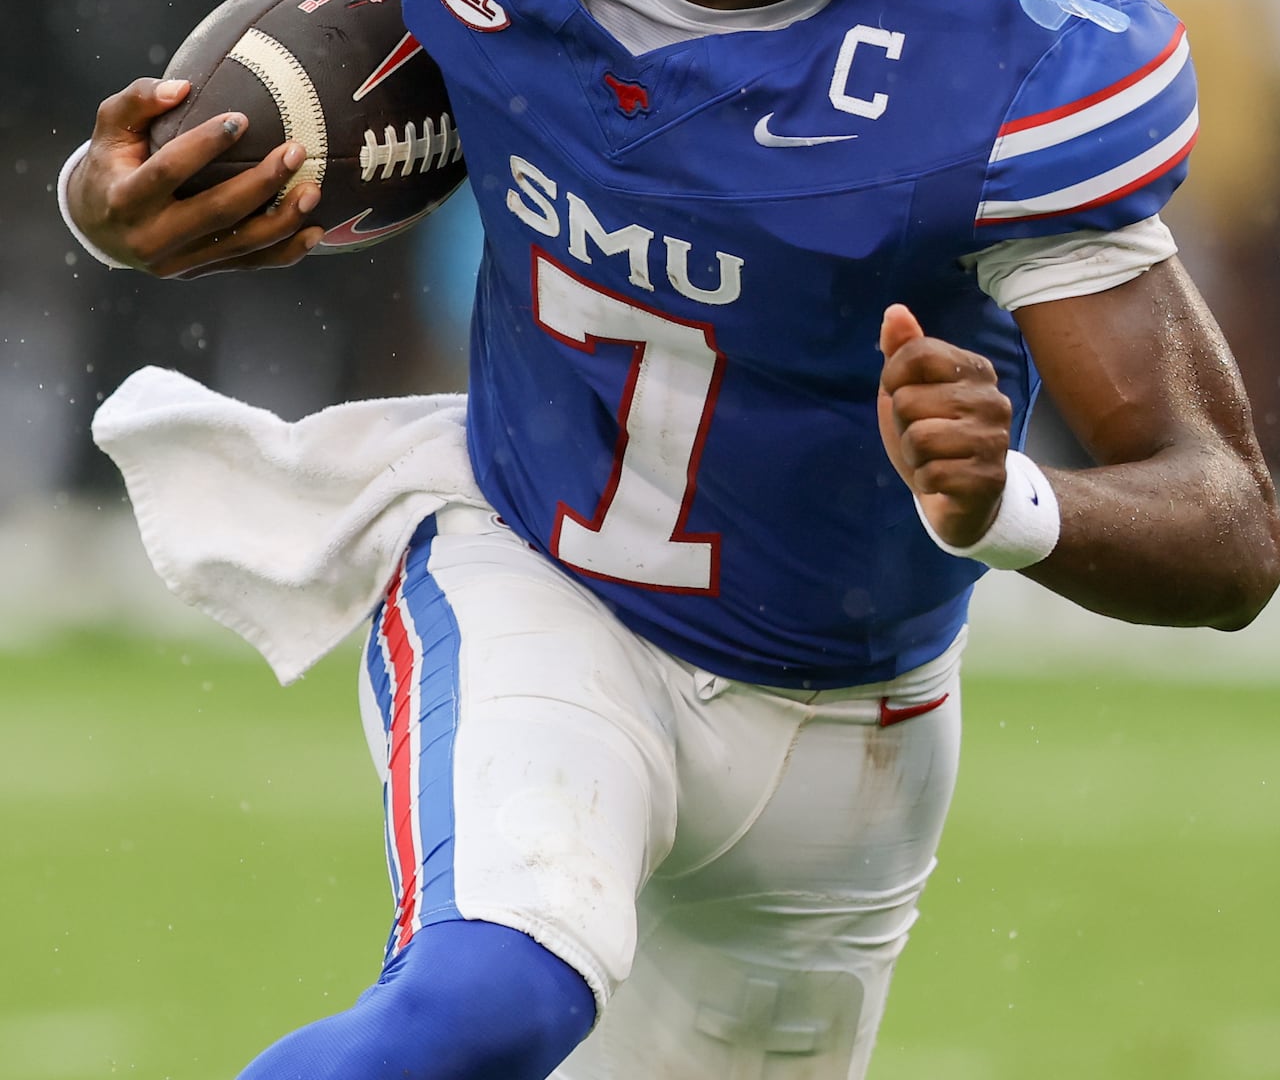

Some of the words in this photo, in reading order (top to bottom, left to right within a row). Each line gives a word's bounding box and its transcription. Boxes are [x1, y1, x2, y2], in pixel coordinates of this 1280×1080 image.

[828, 23, 906, 121] C
[506, 154, 745, 306] SMU
[529, 242, 728, 598] 7
